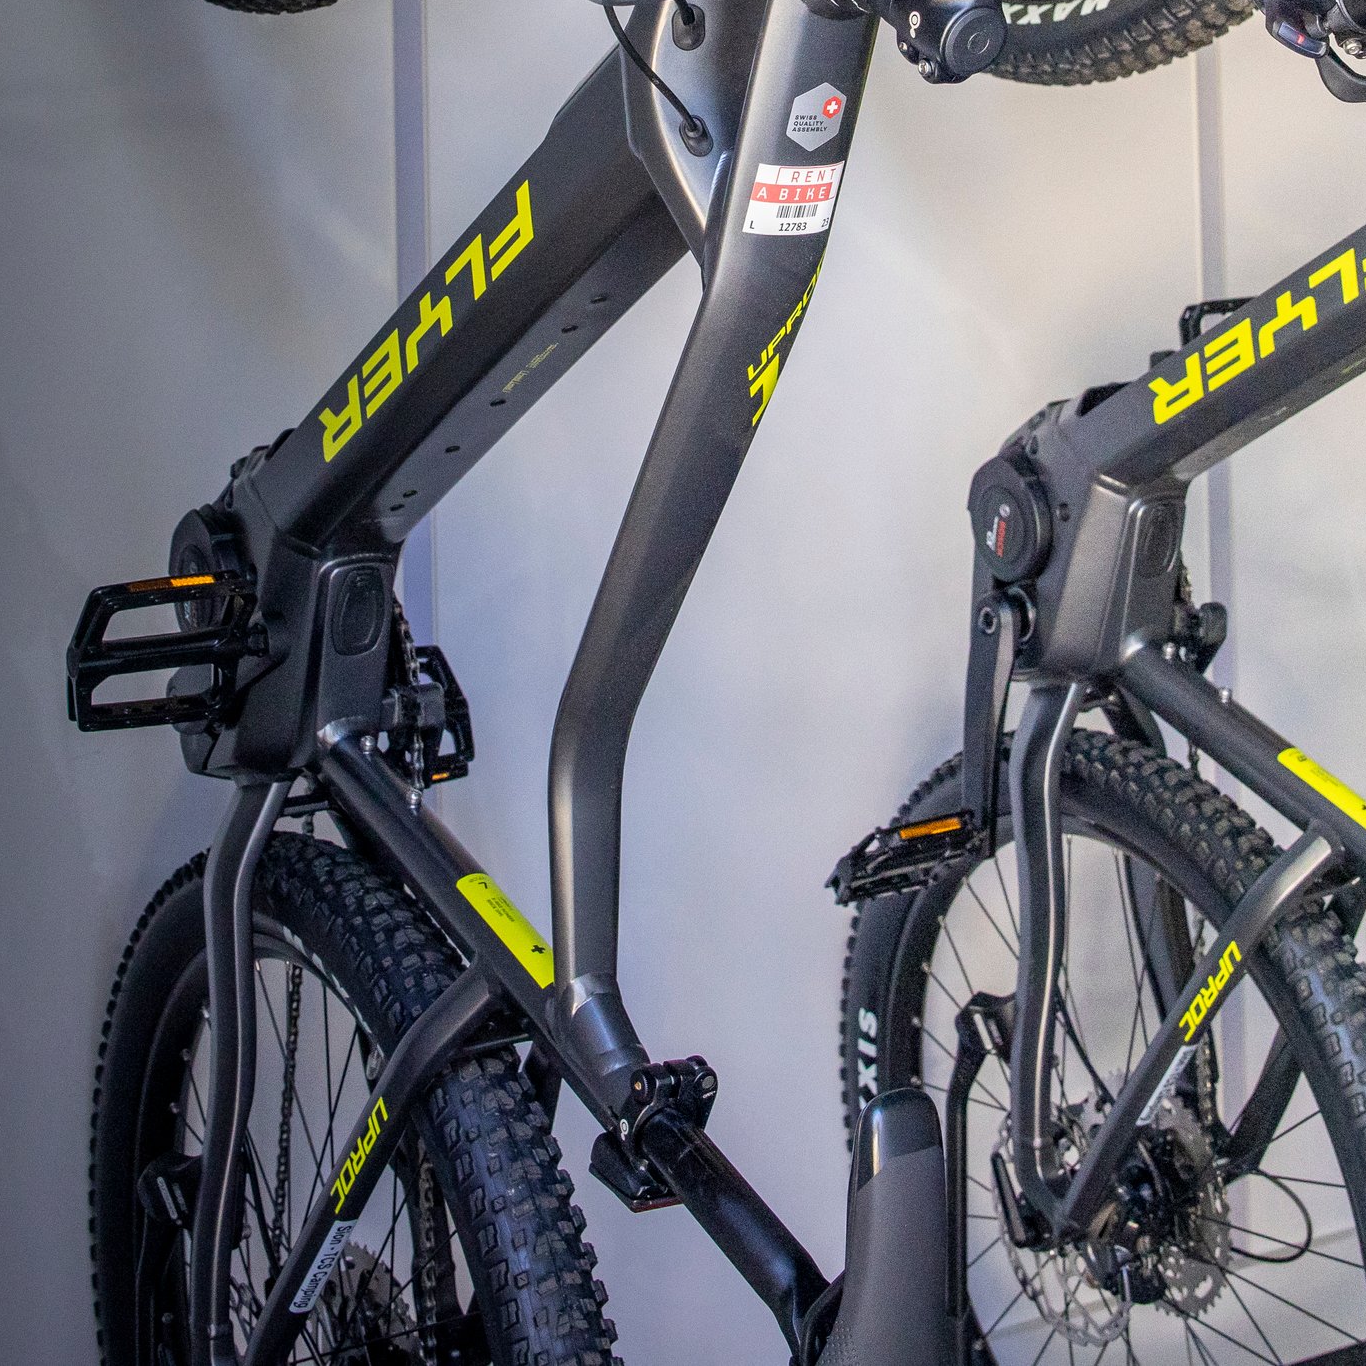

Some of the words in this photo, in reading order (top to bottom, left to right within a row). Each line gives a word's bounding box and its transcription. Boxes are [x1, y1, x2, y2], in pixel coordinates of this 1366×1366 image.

[790, 167, 837, 183] RENT
[756, 186, 768, 199] A
[778, 186, 827, 201] BIKE
[749, 220, 755, 230] L
[778, 222, 808, 232] 12783
[318, 179, 534, 463] FLYER
[747, 246, 827, 378] UPRO
[1179, 941, 1242, 1043] UPROC
[330, 1096, 388, 1215] UPROC
[336, 1225, 352, 1245] Sion
[324, 1252, 339, 1271] TCS
[294, 1269, 327, 1310] Camping
